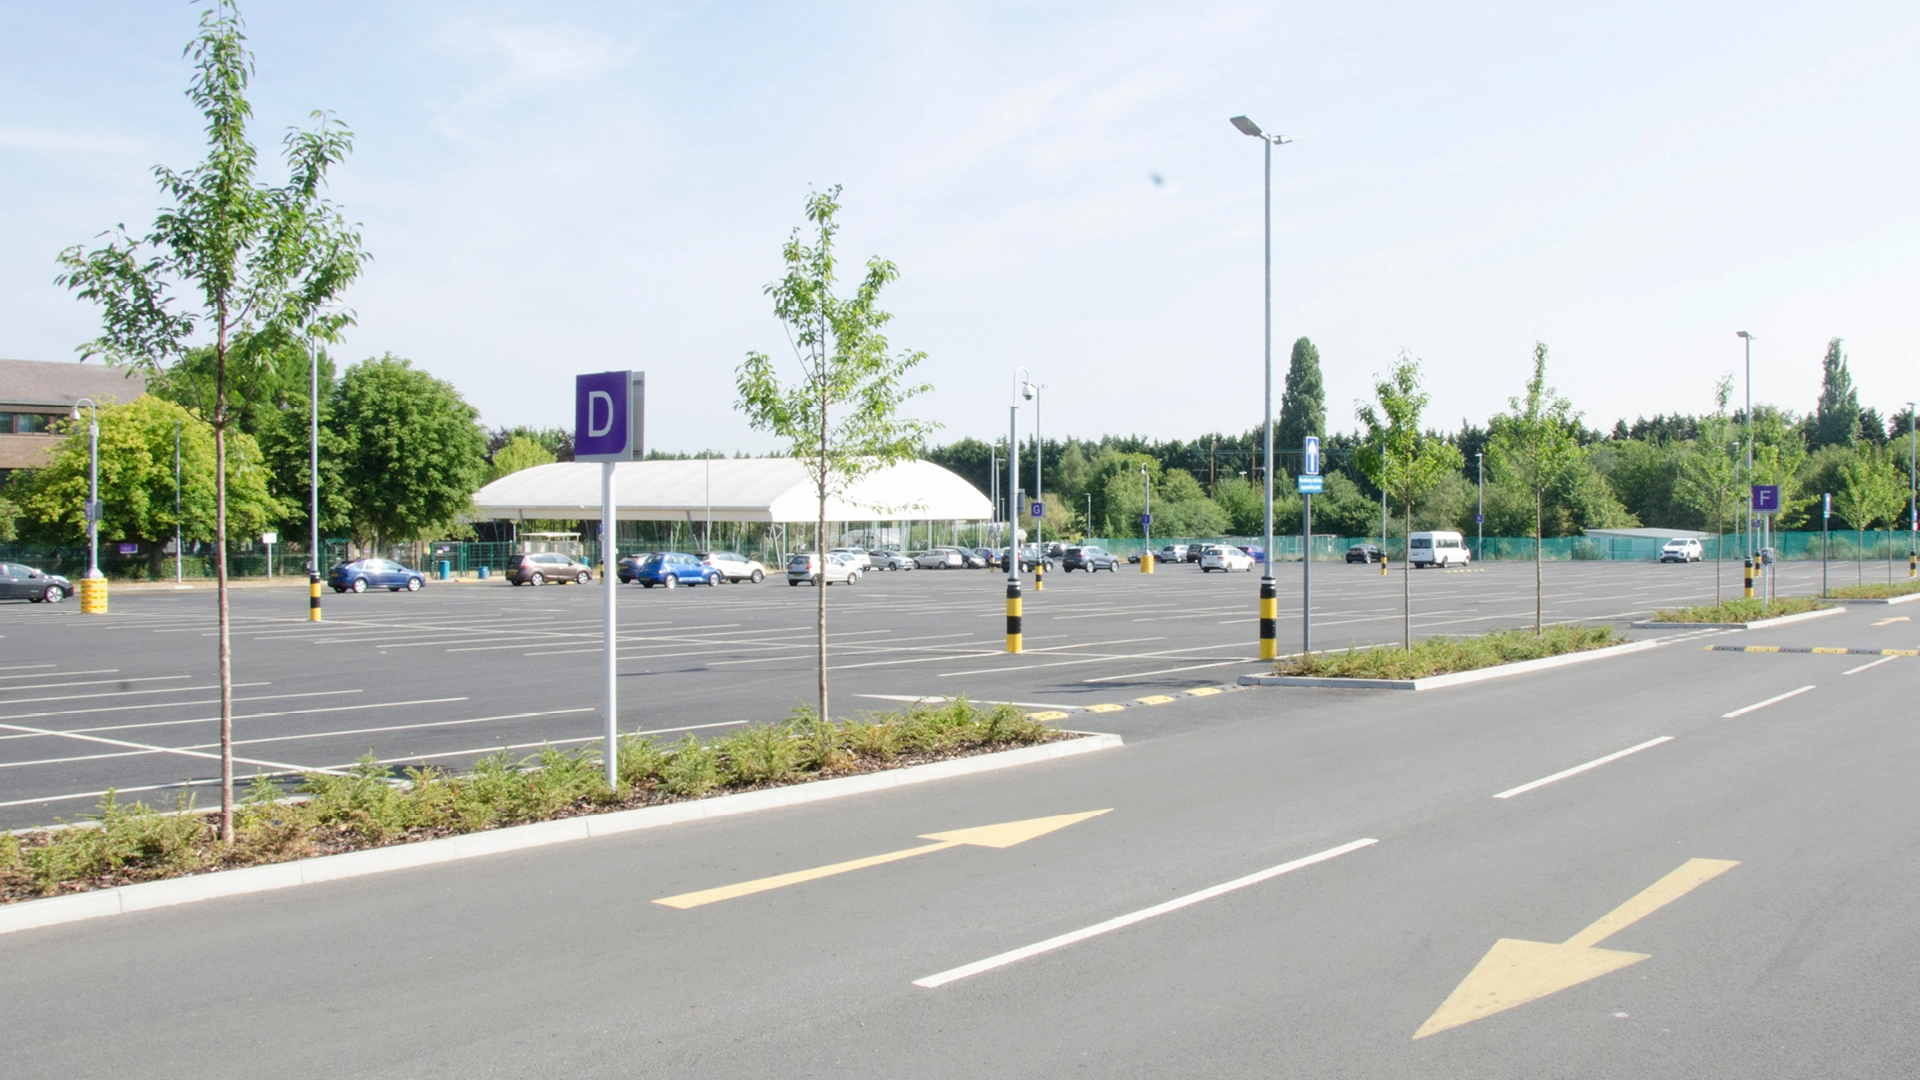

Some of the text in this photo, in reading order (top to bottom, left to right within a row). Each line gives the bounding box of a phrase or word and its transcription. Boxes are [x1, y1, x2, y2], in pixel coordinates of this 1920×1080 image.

[588, 390, 614, 437] D
[1760, 490, 1771, 505] F
[1033, 504, 1041, 515] G
